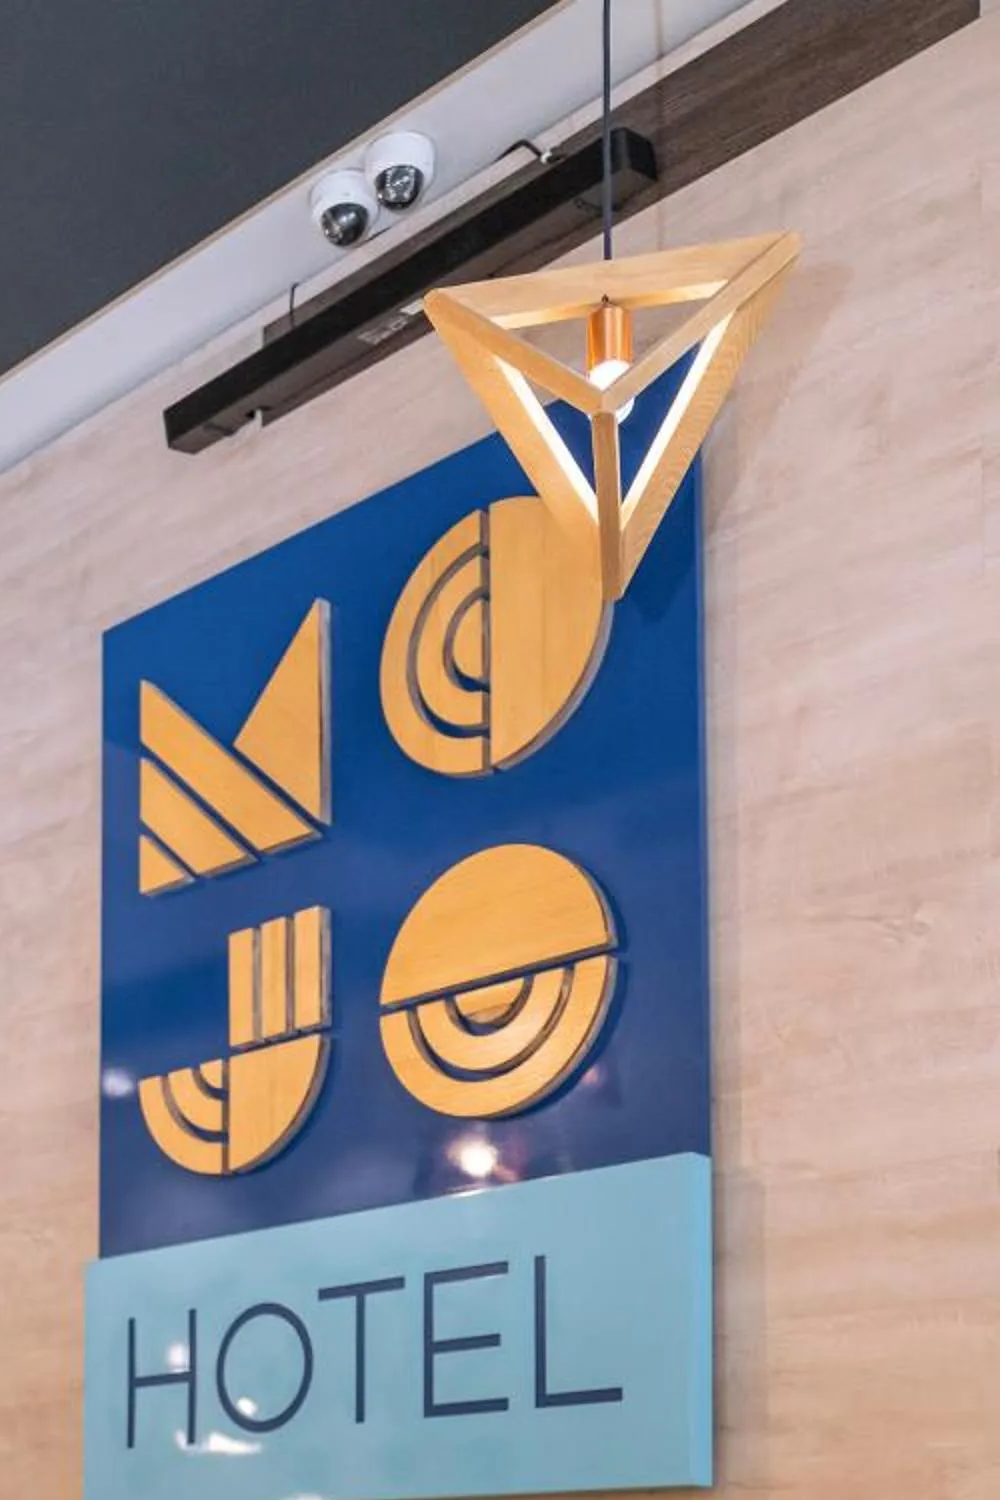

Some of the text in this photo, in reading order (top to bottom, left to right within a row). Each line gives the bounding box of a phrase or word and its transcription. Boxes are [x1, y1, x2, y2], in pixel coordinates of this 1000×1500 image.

[139, 494, 616, 895] MO
[139, 842, 620, 1176] JO
[127, 1254, 624, 1449] HOTEL
